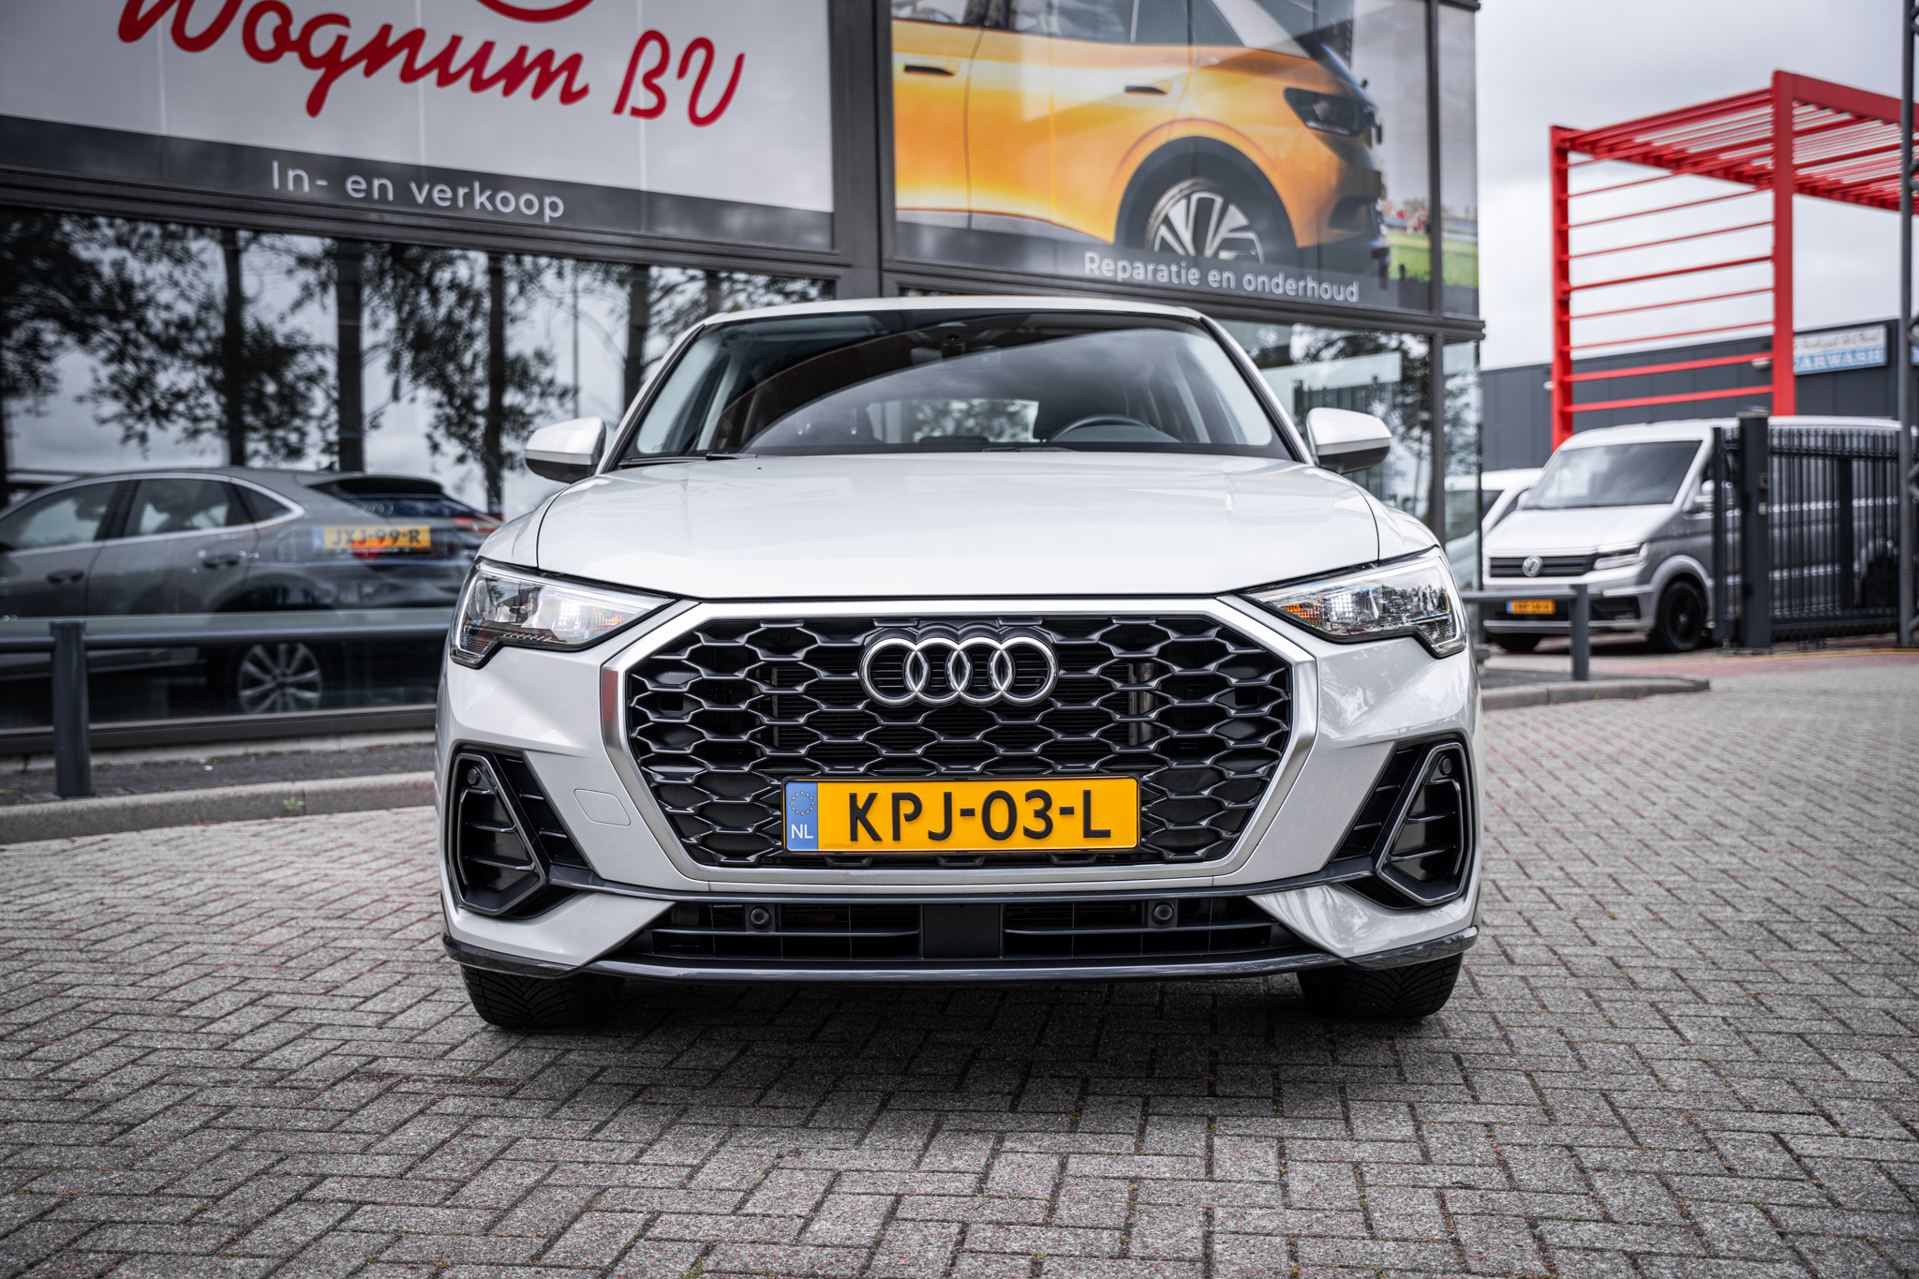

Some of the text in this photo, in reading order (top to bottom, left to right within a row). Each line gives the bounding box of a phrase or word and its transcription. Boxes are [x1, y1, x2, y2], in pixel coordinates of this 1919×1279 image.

[612, 29, 746, 127] BV
[272, 160, 564, 223] In- en verkoop
[1084, 251, 1359, 303] Reparatie en onderhoud
[332, 527, 421, 546] JXJ-99-R
[791, 789, 1111, 841] NL KPJ-03-L
